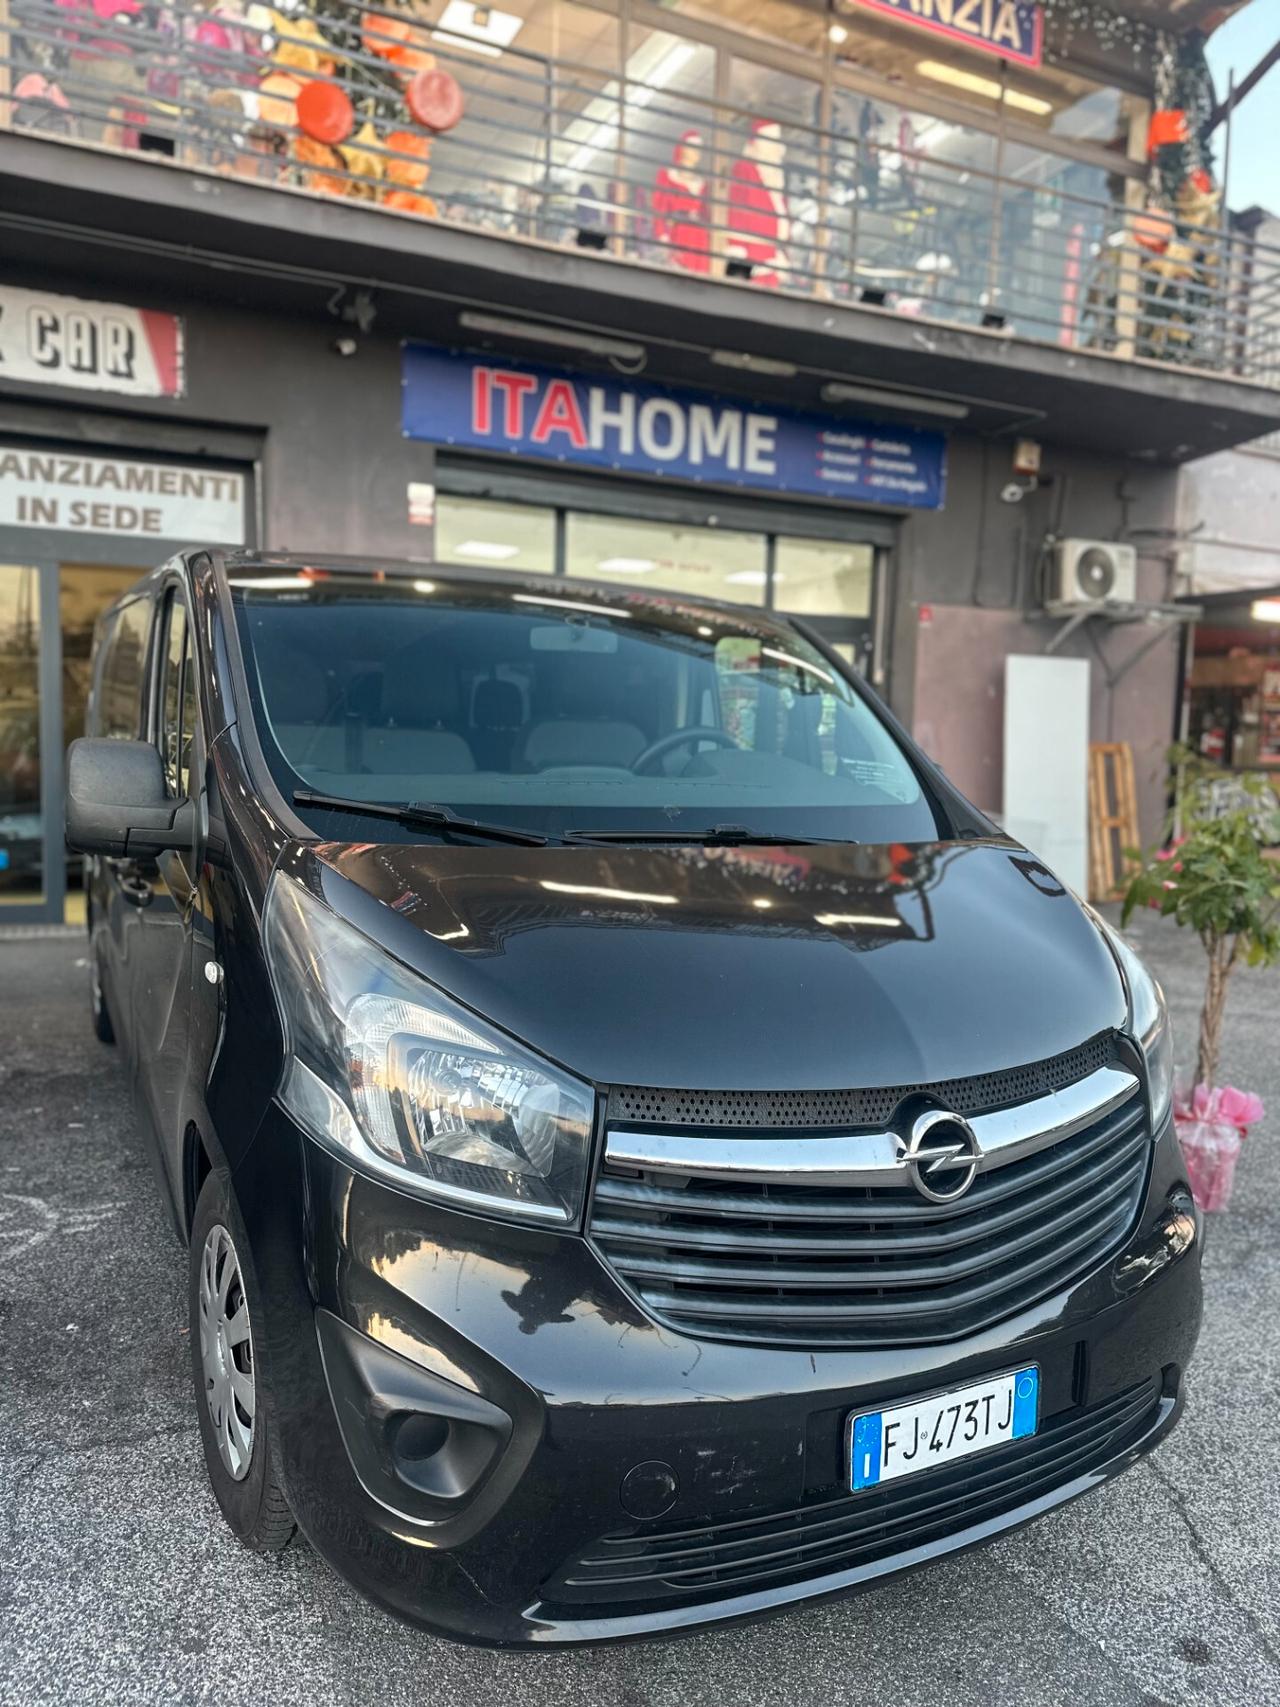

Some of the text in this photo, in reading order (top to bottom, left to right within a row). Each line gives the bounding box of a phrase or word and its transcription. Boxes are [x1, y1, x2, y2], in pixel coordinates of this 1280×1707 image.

[27, 305, 135, 380] CAR
[472, 366, 778, 476] ITAHOME
[17, 496, 162, 533] IN SEDE
